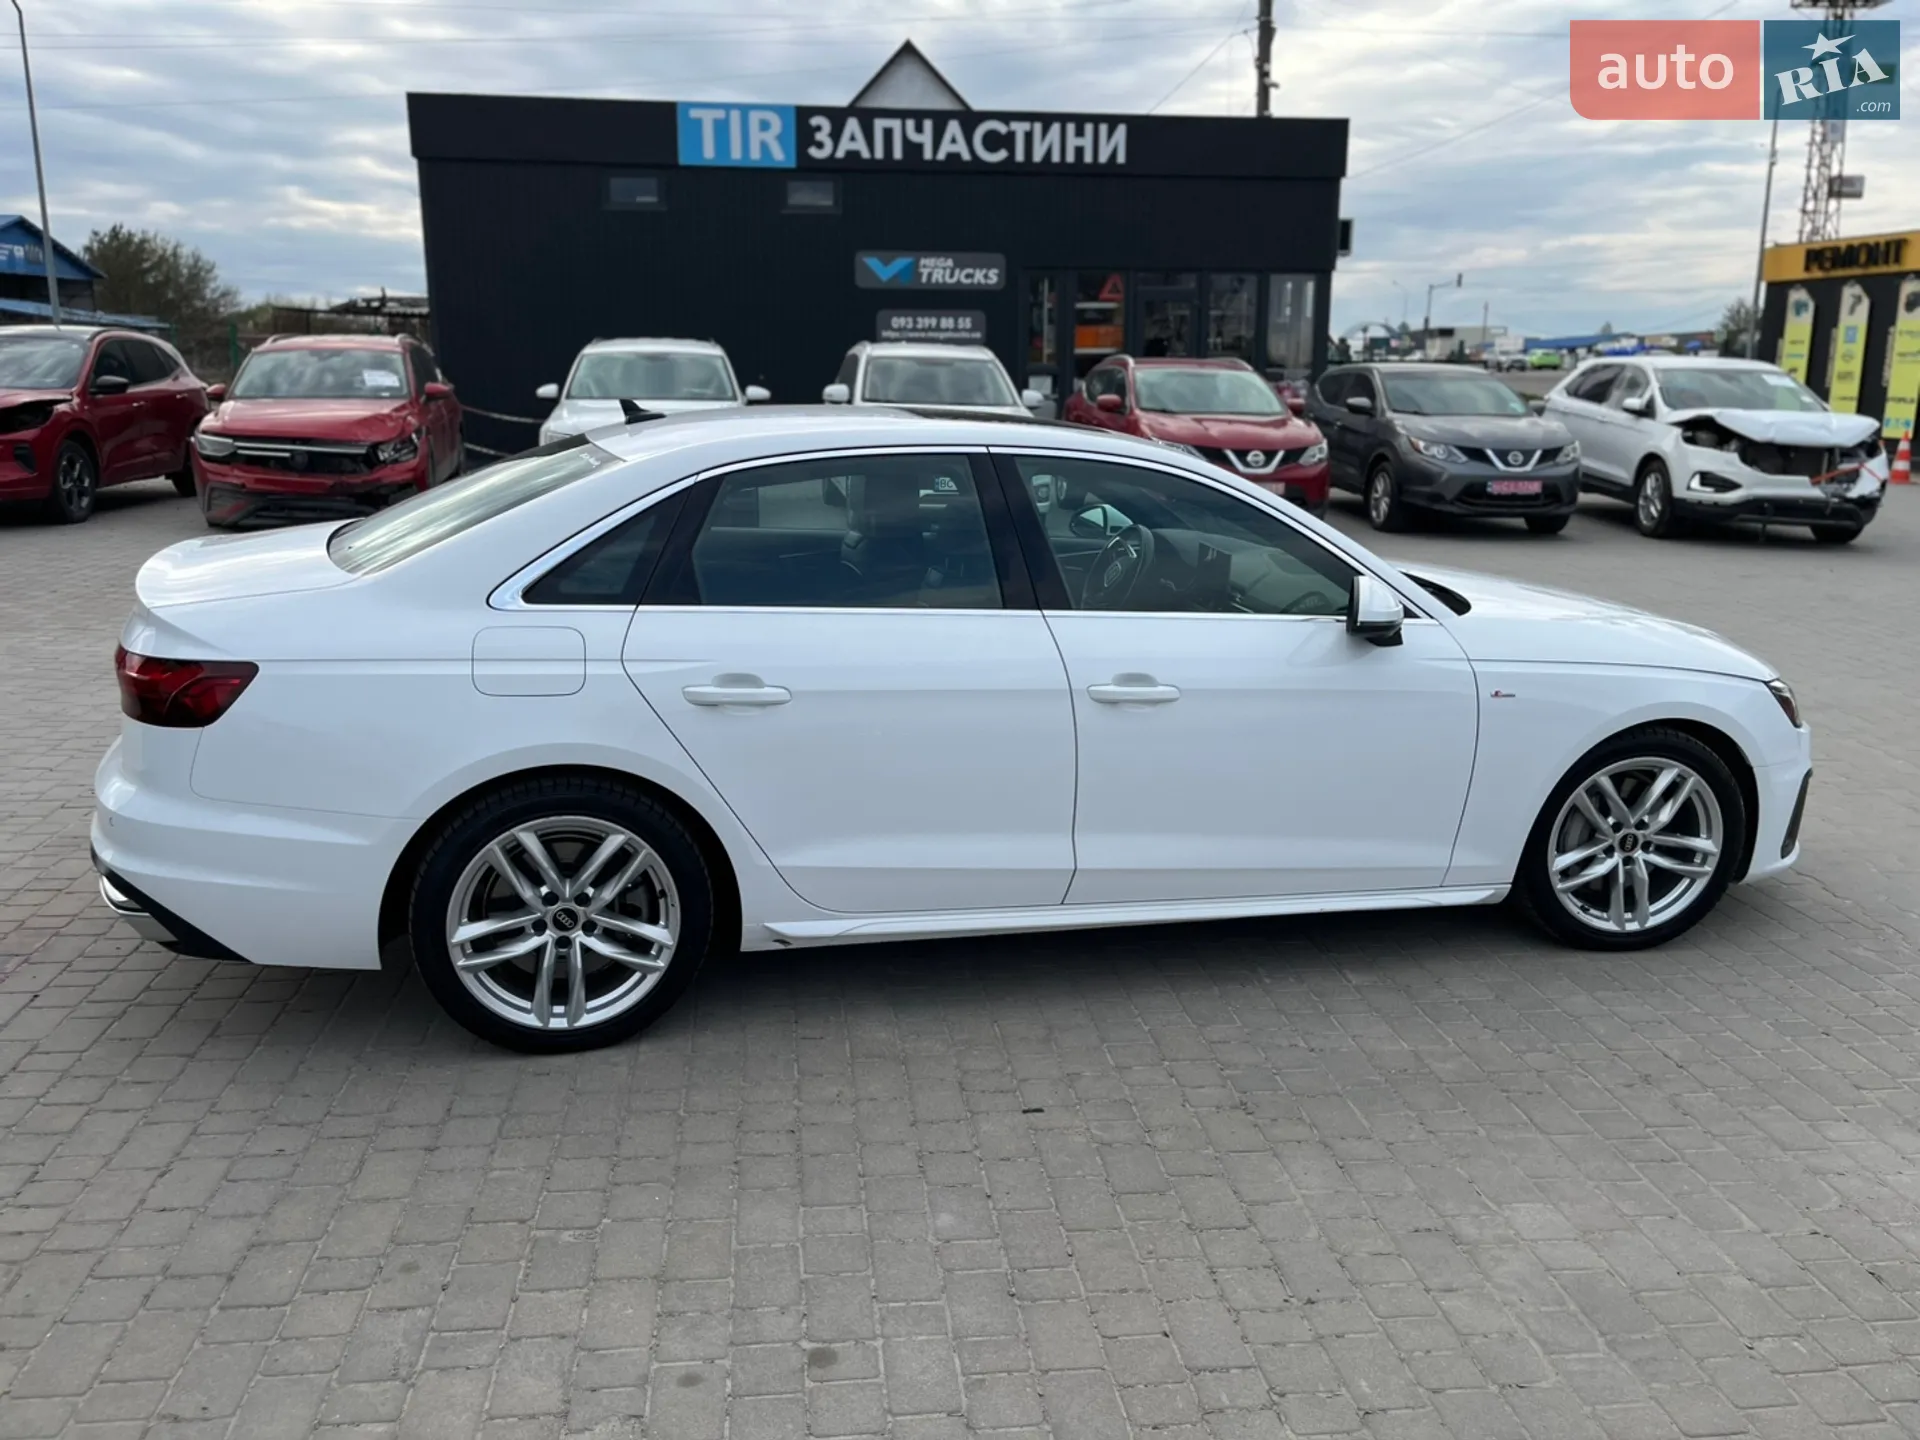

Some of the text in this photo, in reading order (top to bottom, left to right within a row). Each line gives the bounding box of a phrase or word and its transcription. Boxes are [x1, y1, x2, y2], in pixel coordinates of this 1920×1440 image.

[688, 108, 1128, 165] TIR ЗАПЧАСТИНИ
[919, 257, 954, 267] MEGA
[1804, 239, 1908, 272] РЕМОНТ
[918, 268, 999, 285] TRUCKS
[891, 316, 914, 329] 093
[957, 316, 973, 329] 55
